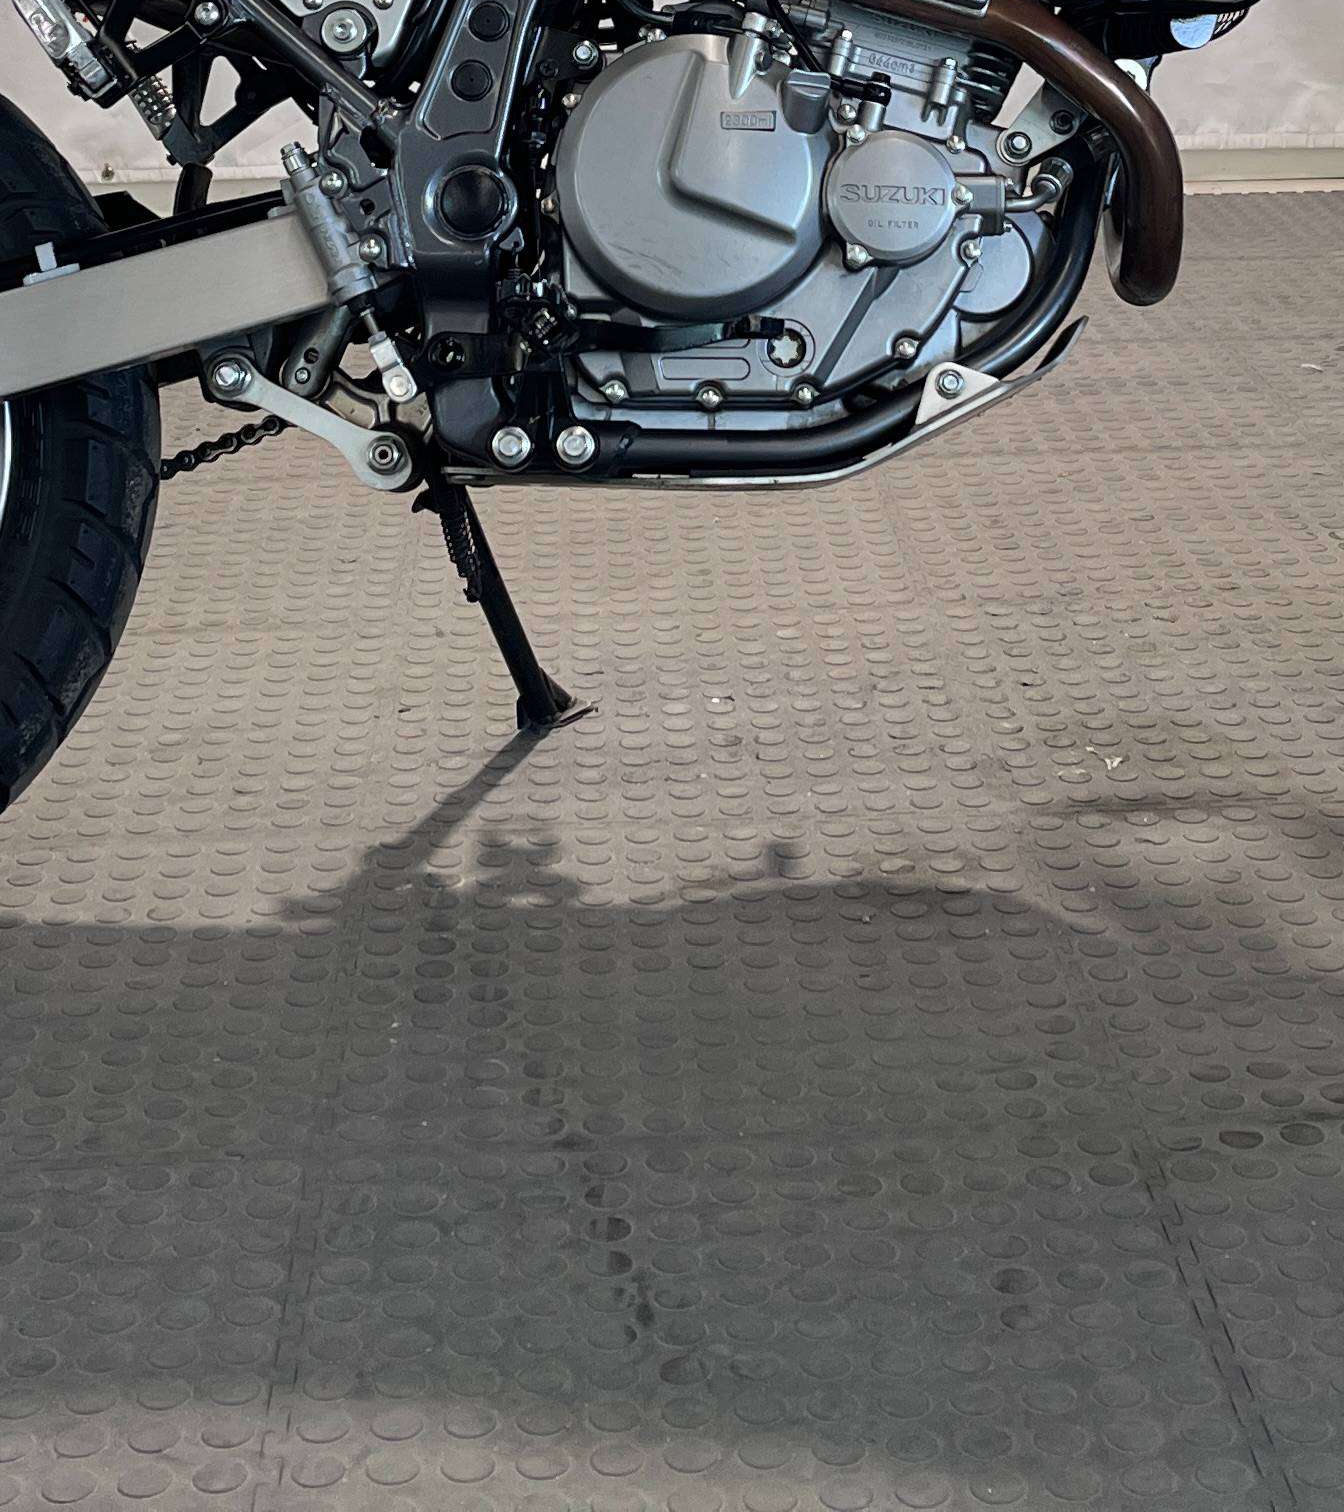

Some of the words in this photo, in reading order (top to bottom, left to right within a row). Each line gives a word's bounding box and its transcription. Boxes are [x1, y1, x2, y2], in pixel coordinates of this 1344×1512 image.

[724, 112, 774, 128] 2300ml
[839, 183, 945, 206] SUZUKI
[867, 219, 883, 229] OIL
[887, 219, 920, 230] FILTER
